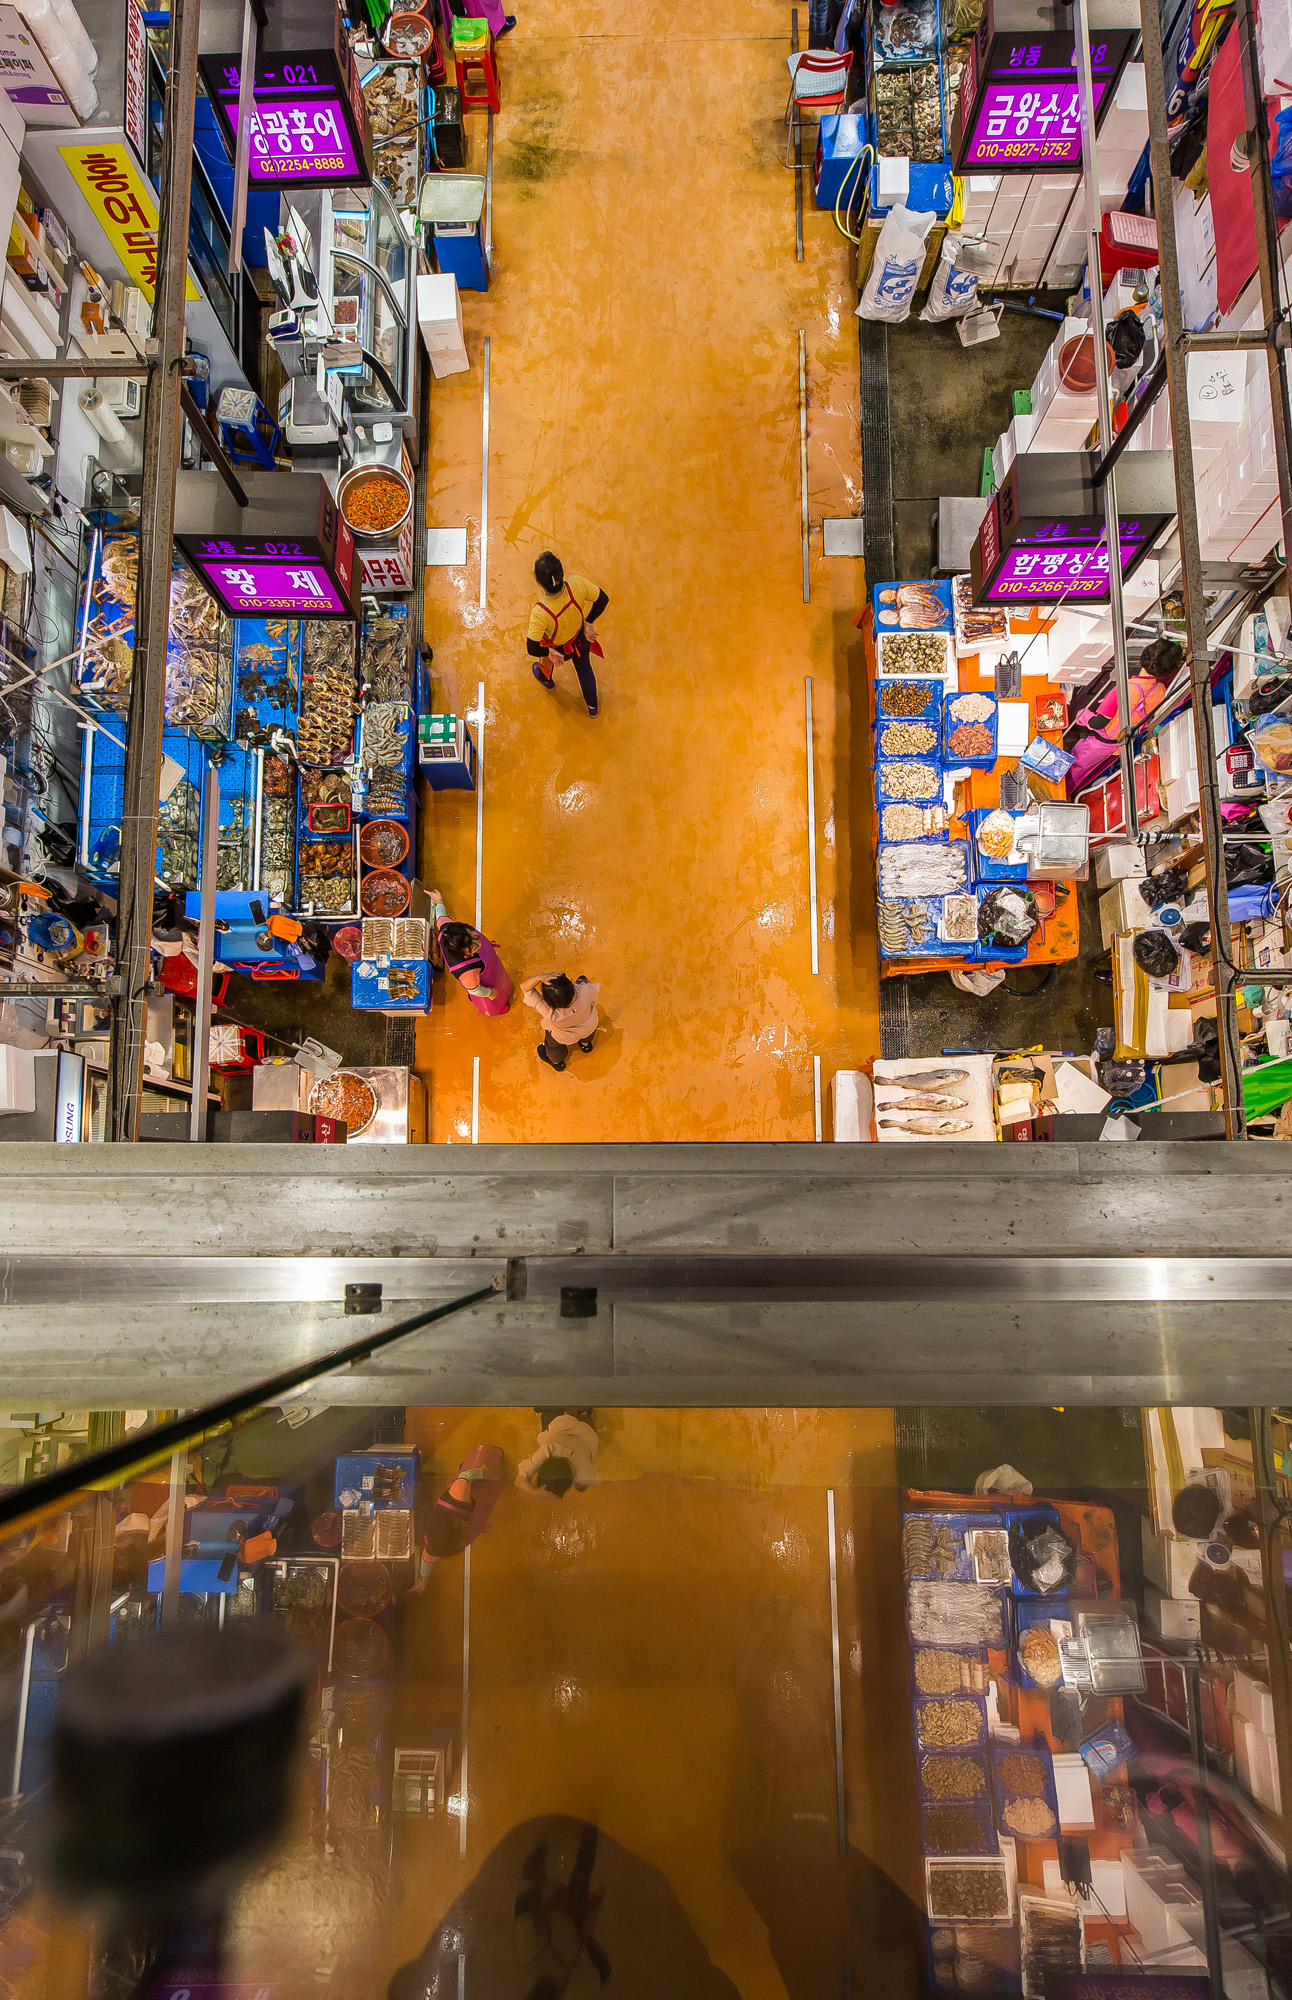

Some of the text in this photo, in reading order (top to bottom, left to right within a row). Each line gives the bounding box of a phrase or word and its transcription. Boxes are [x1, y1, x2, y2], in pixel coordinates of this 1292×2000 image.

[1009, 45, 1042, 67] 냉동
[223, 66, 256, 87] 냉
[283, 65, 317, 84] 021
[986, 92, 1081, 136] 금왕수산
[976, 142, 1071, 157] 010-8927-6752
[260, 157, 345, 174] 02)2254-8888
[1035, 523, 1071, 537] 냉동
[201, 540, 236, 554] 냉동
[264, 542, 304, 555] 022
[998, 580, 1104, 594] 010-5266-3787
[239, 597, 333, 609] 010-3357-2033
